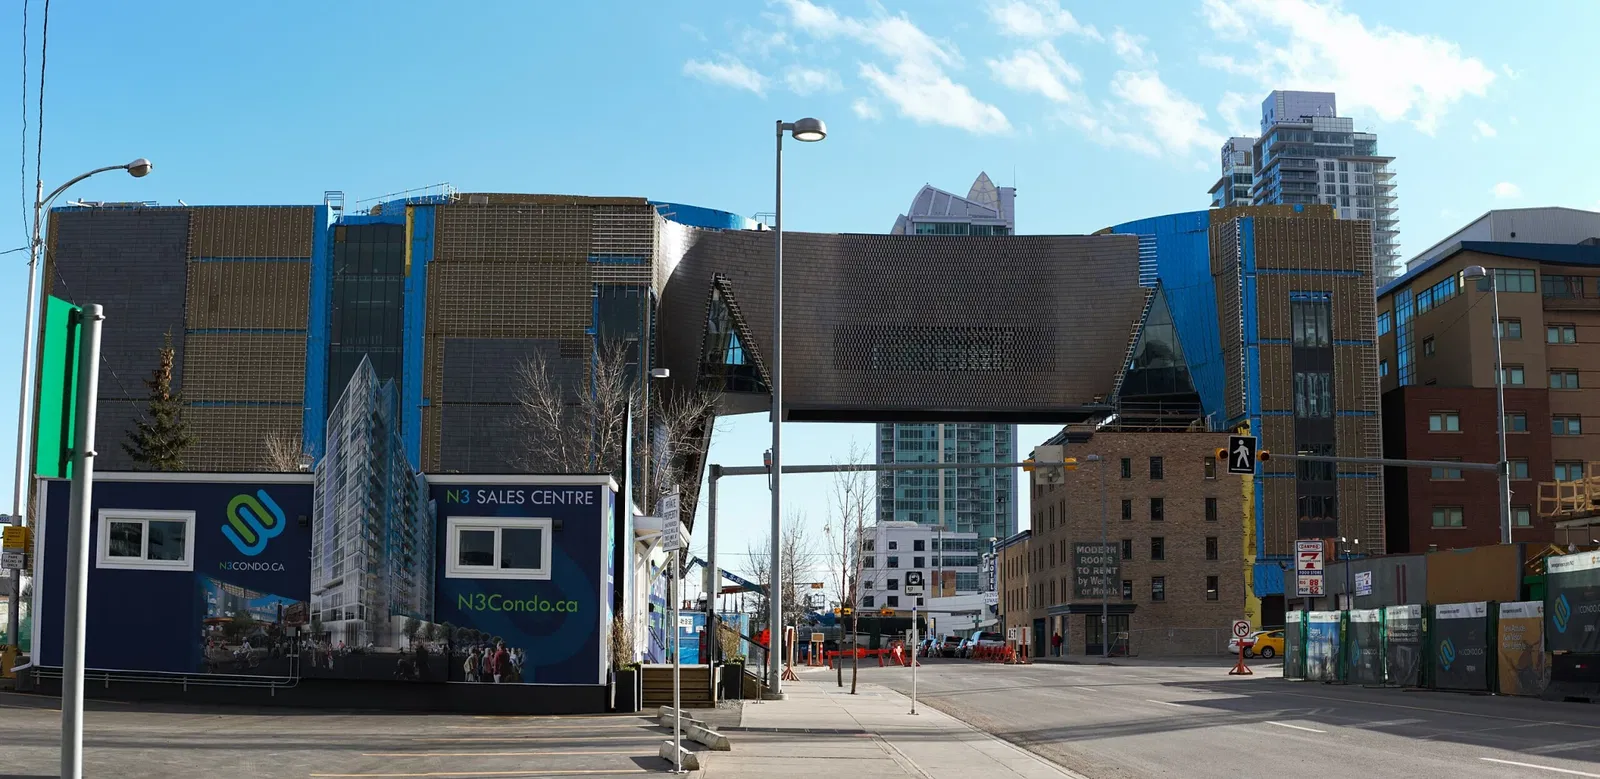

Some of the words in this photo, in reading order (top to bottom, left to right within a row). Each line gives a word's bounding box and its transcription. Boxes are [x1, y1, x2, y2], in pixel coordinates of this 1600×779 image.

[447, 489, 470, 503] N3
[476, 489, 525, 505] SALES
[530, 490, 594, 505] CENTRE
[1076, 546, 1117, 554] MODERN
[218, 561, 286, 572] N3CONDO.CA
[1077, 566, 1090, 574] TO
[1092, 567, 1118, 575] RENT
[1077, 576, 1089, 588] by
[1090, 576, 1112, 585] Wek
[1309, 586, 1319, 594] 52
[457, 593, 578, 613] N3Condo.ca
